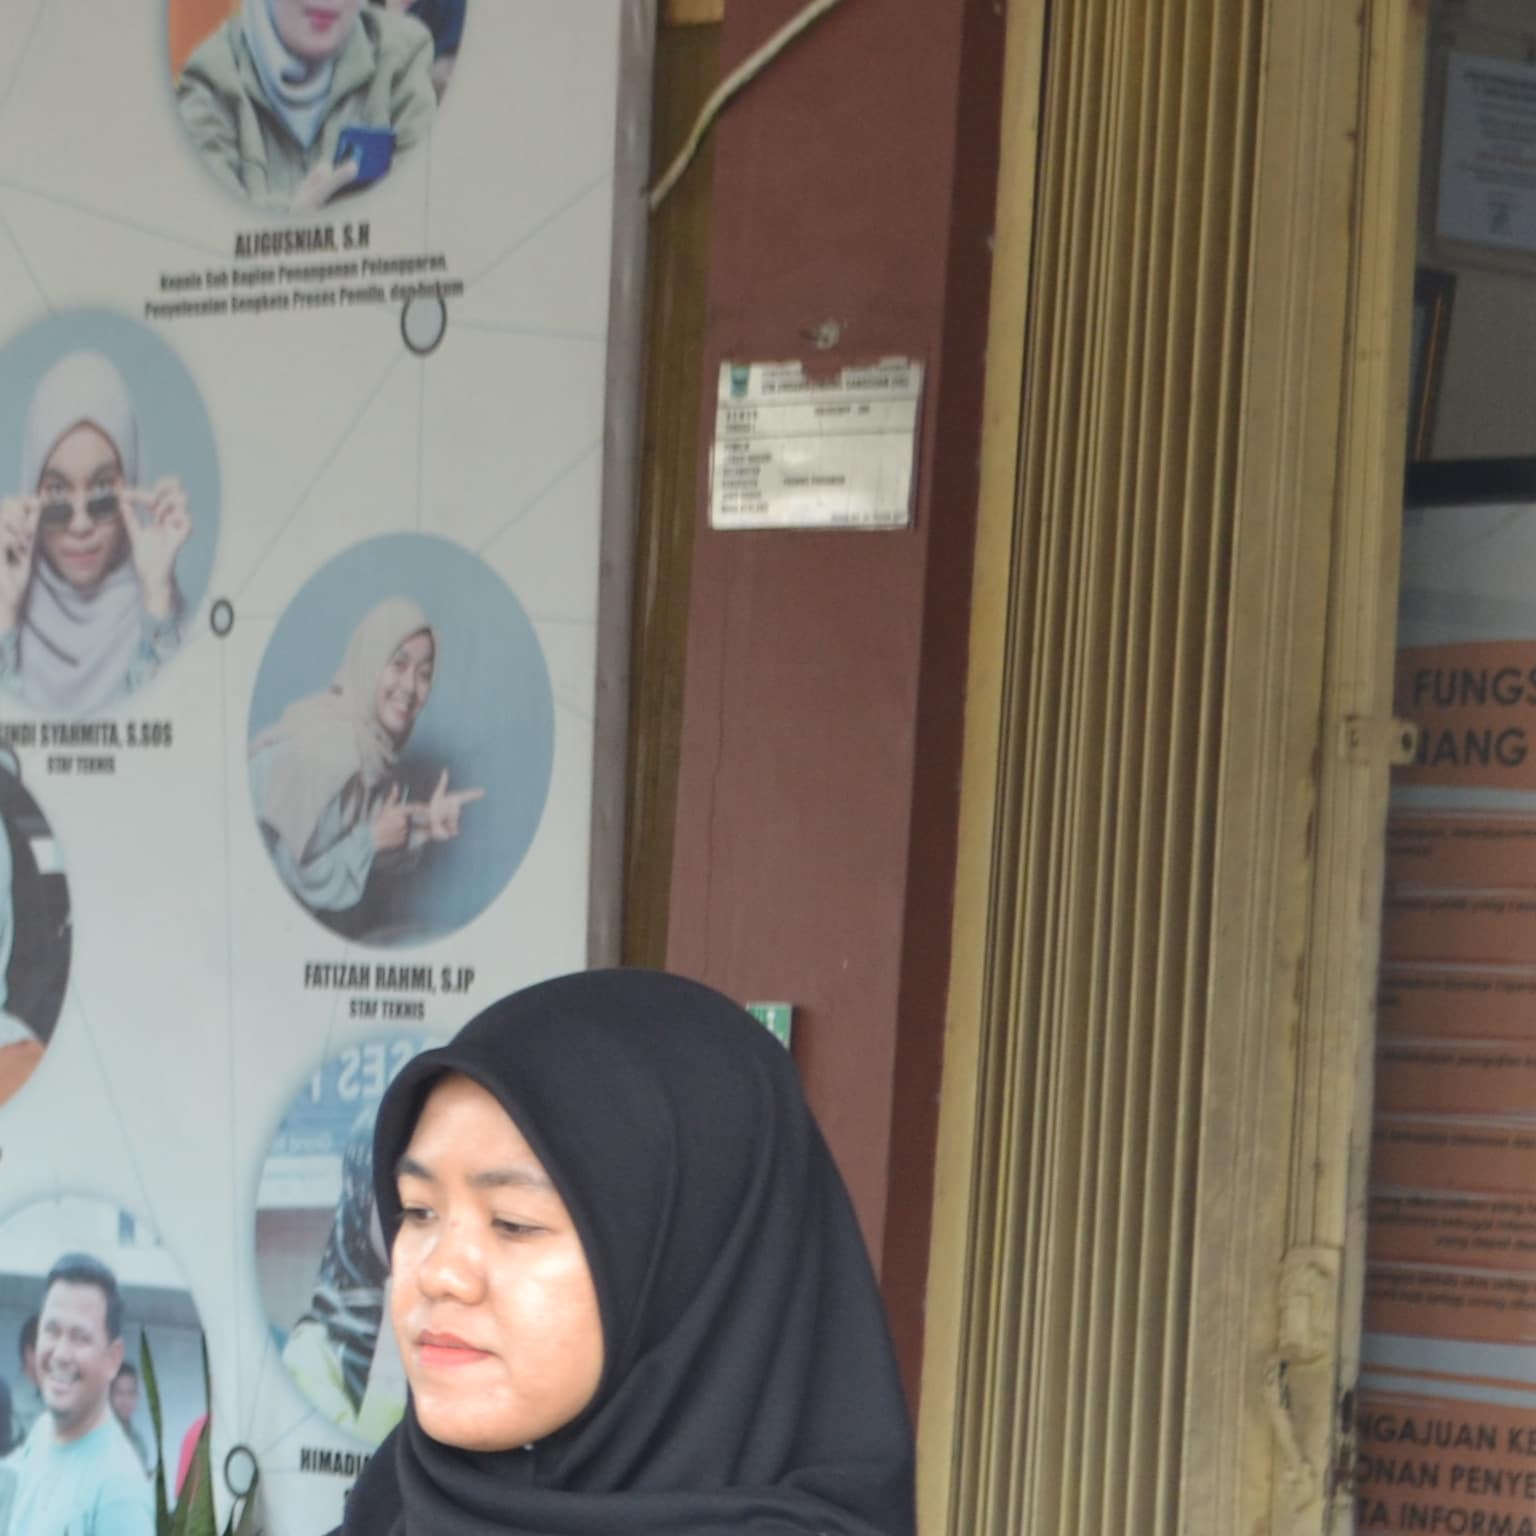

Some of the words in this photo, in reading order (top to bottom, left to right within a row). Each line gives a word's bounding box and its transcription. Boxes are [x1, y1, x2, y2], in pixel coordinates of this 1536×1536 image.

[303, 962, 371, 992] FATIZAH
[348, 997, 378, 1020] STAF
[381, 999, 426, 1021] TEKNIS
[1356, 1411, 1498, 1453] NGAJUAN
[1355, 1451, 1440, 1490] ONAN
